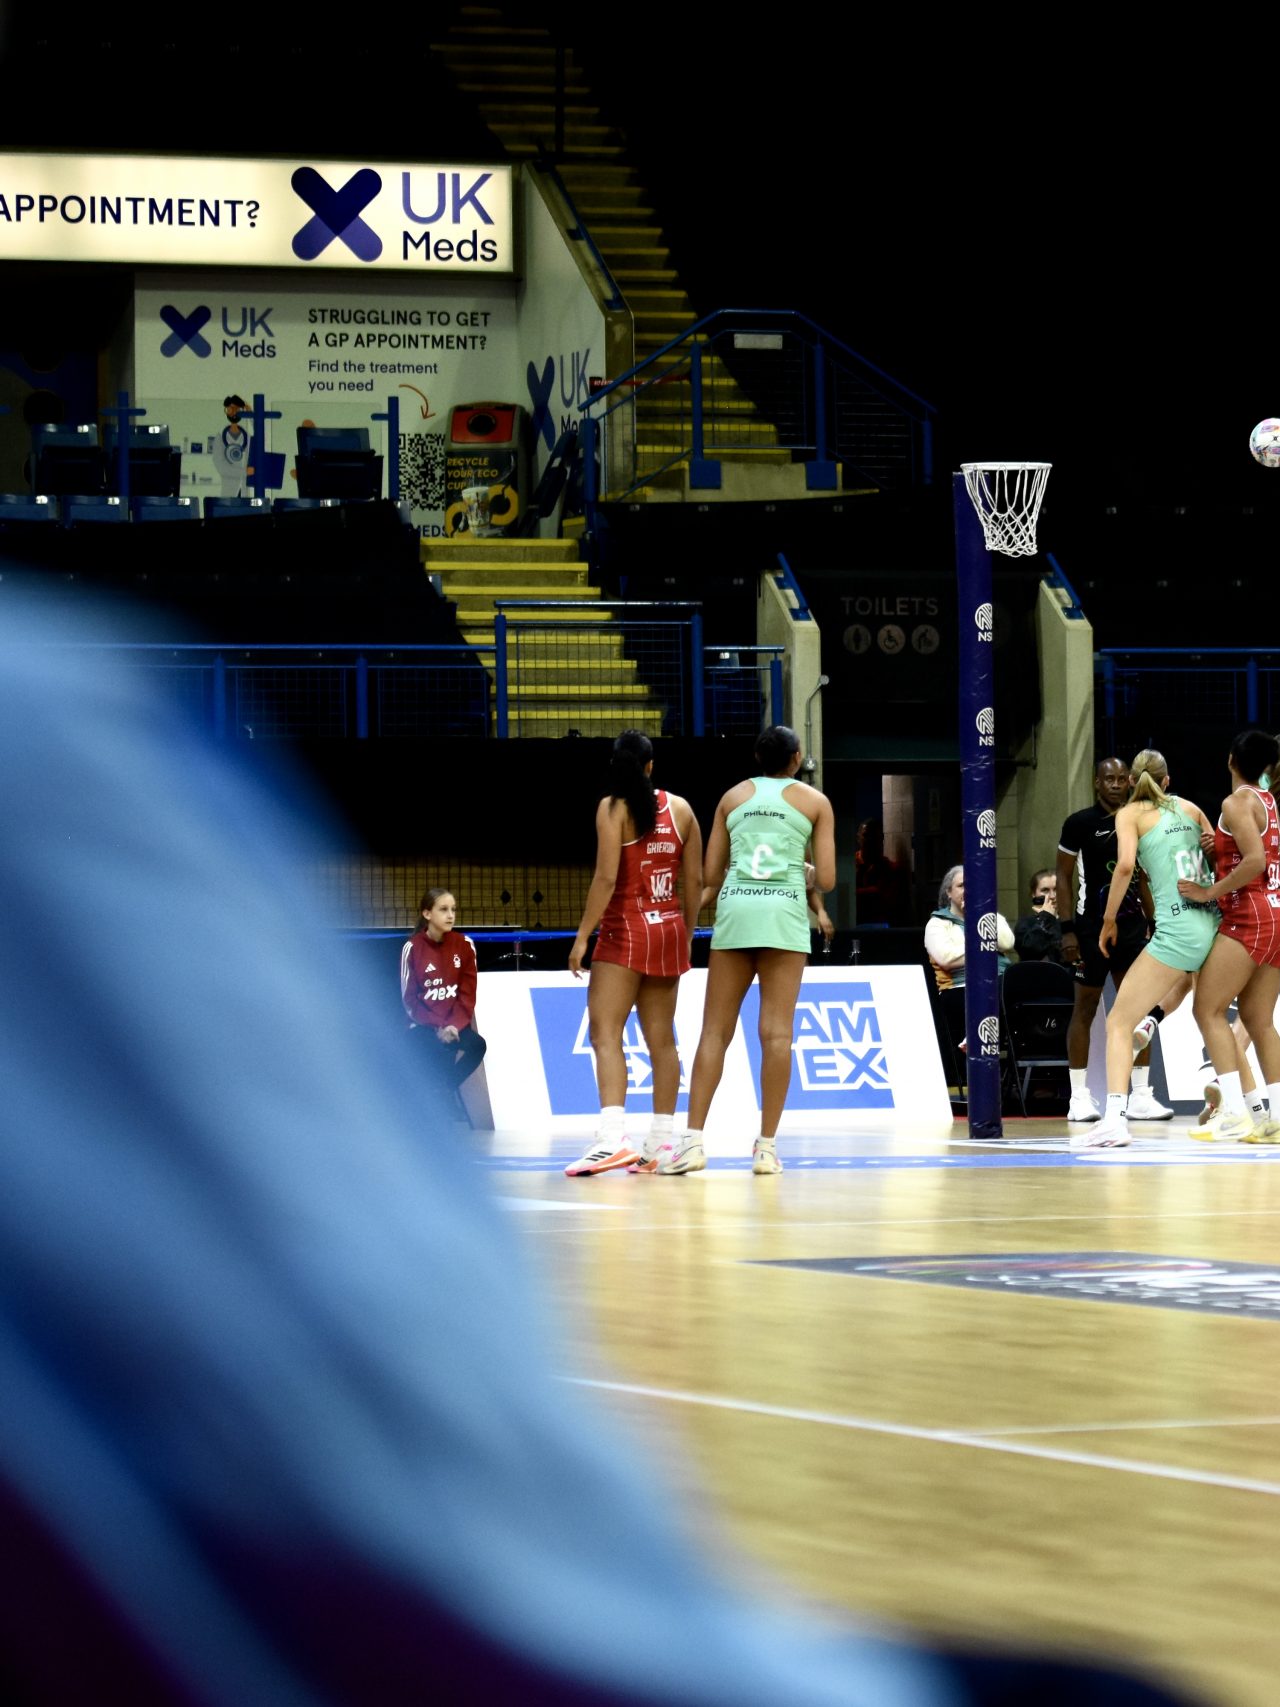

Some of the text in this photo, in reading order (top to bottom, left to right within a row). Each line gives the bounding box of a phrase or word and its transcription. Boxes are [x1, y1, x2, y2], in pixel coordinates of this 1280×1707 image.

[402, 171, 495, 225] UK
[403, 229, 498, 262] Meds
[222, 307, 275, 337] UK
[308, 308, 491, 327] STRUGGLING TO GET
[222, 339, 276, 358] Meds
[308, 332, 487, 350] A GP APPOINTMENT?
[308, 360, 438, 374] Find the treatment
[308, 379, 374, 394] you need
[446, 456, 490, 466] RECYCLE
[447, 468, 499, 478] YOUR ECO
[840, 596, 939, 616] TOILETS
[743, 810, 785, 819] PHILLIPS
[1164, 825, 1192, 835] SADLER
[751, 844, 774, 880] C
[730, 887, 799, 901] shawbrook
[793, 1006, 882, 1044] AM
[1045, 1018, 1056, 1028] 16
[802, 1047, 890, 1085] EX
